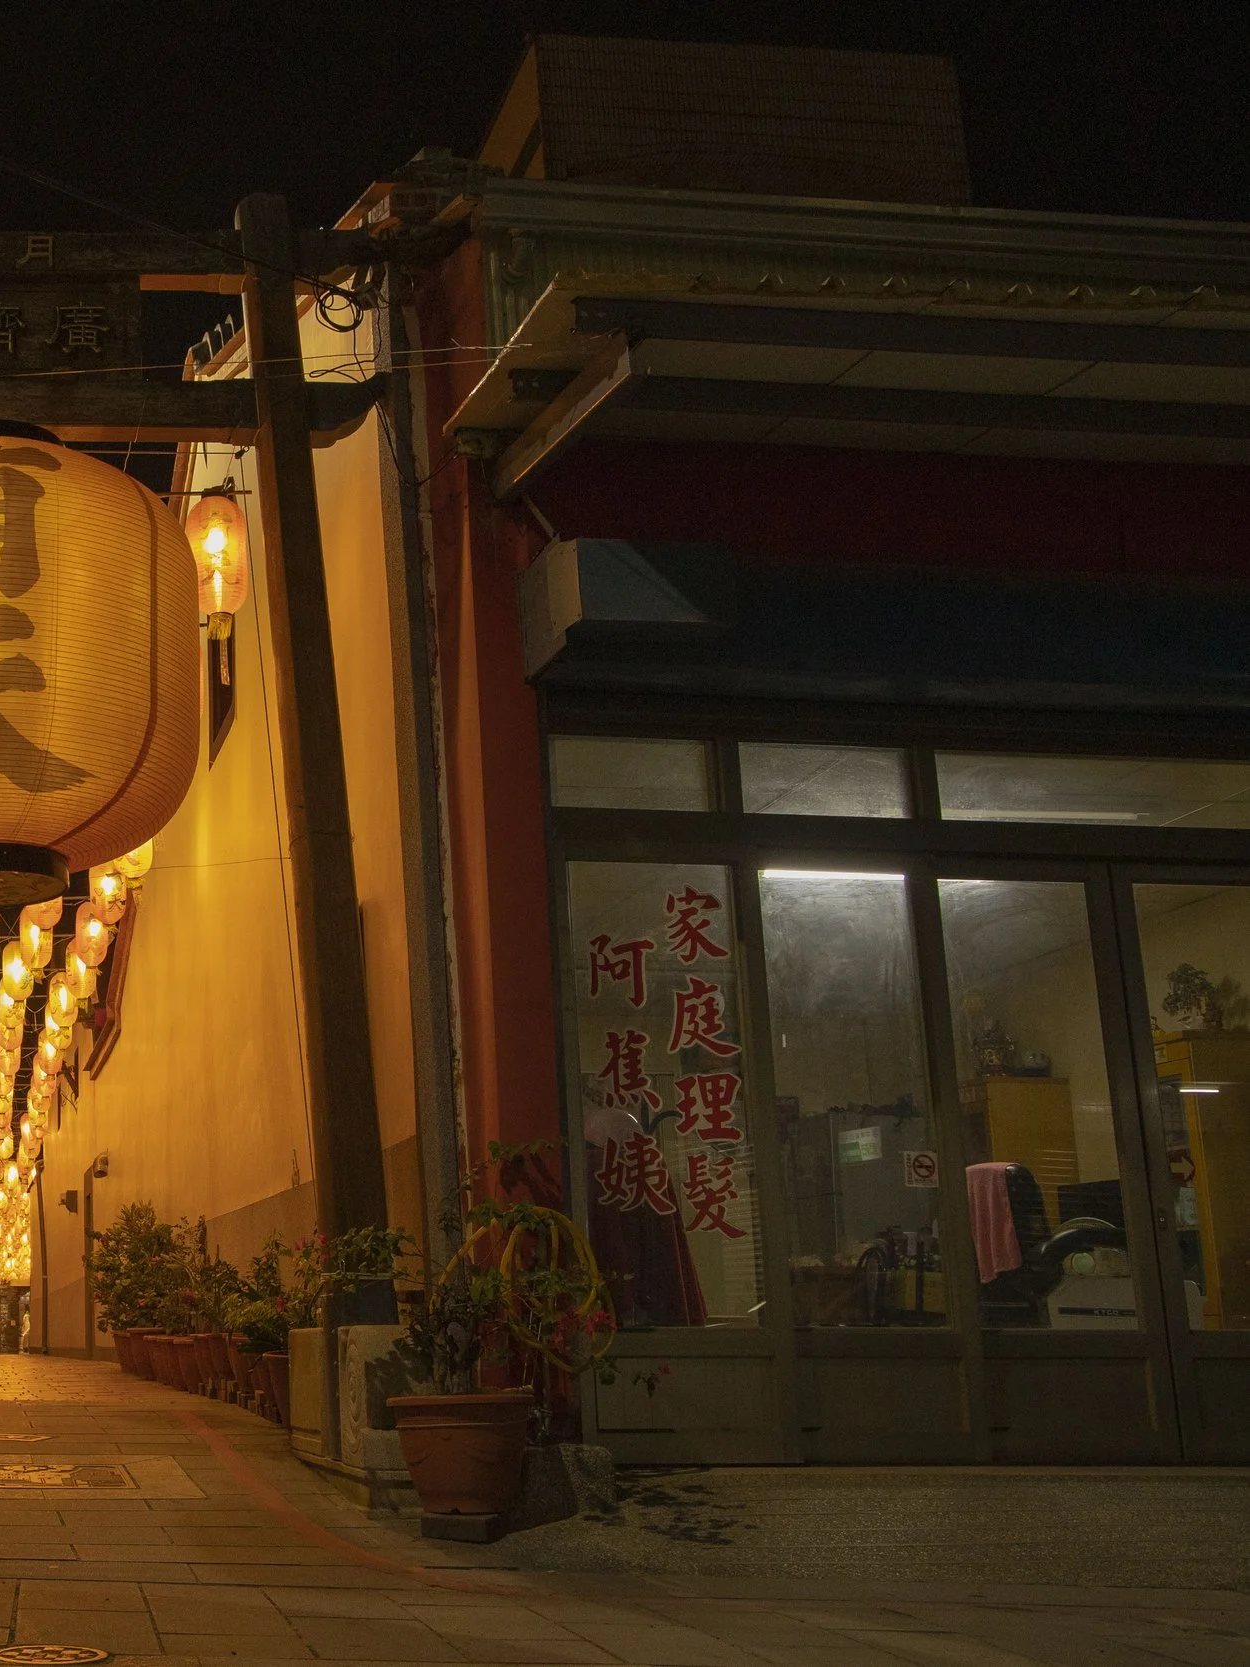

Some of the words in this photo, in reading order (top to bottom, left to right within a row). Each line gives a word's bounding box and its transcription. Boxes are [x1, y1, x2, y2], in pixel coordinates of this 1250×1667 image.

[588, 932, 676, 1215] 阿蕉姨
[665, 885, 749, 1240] 家庭理髮
